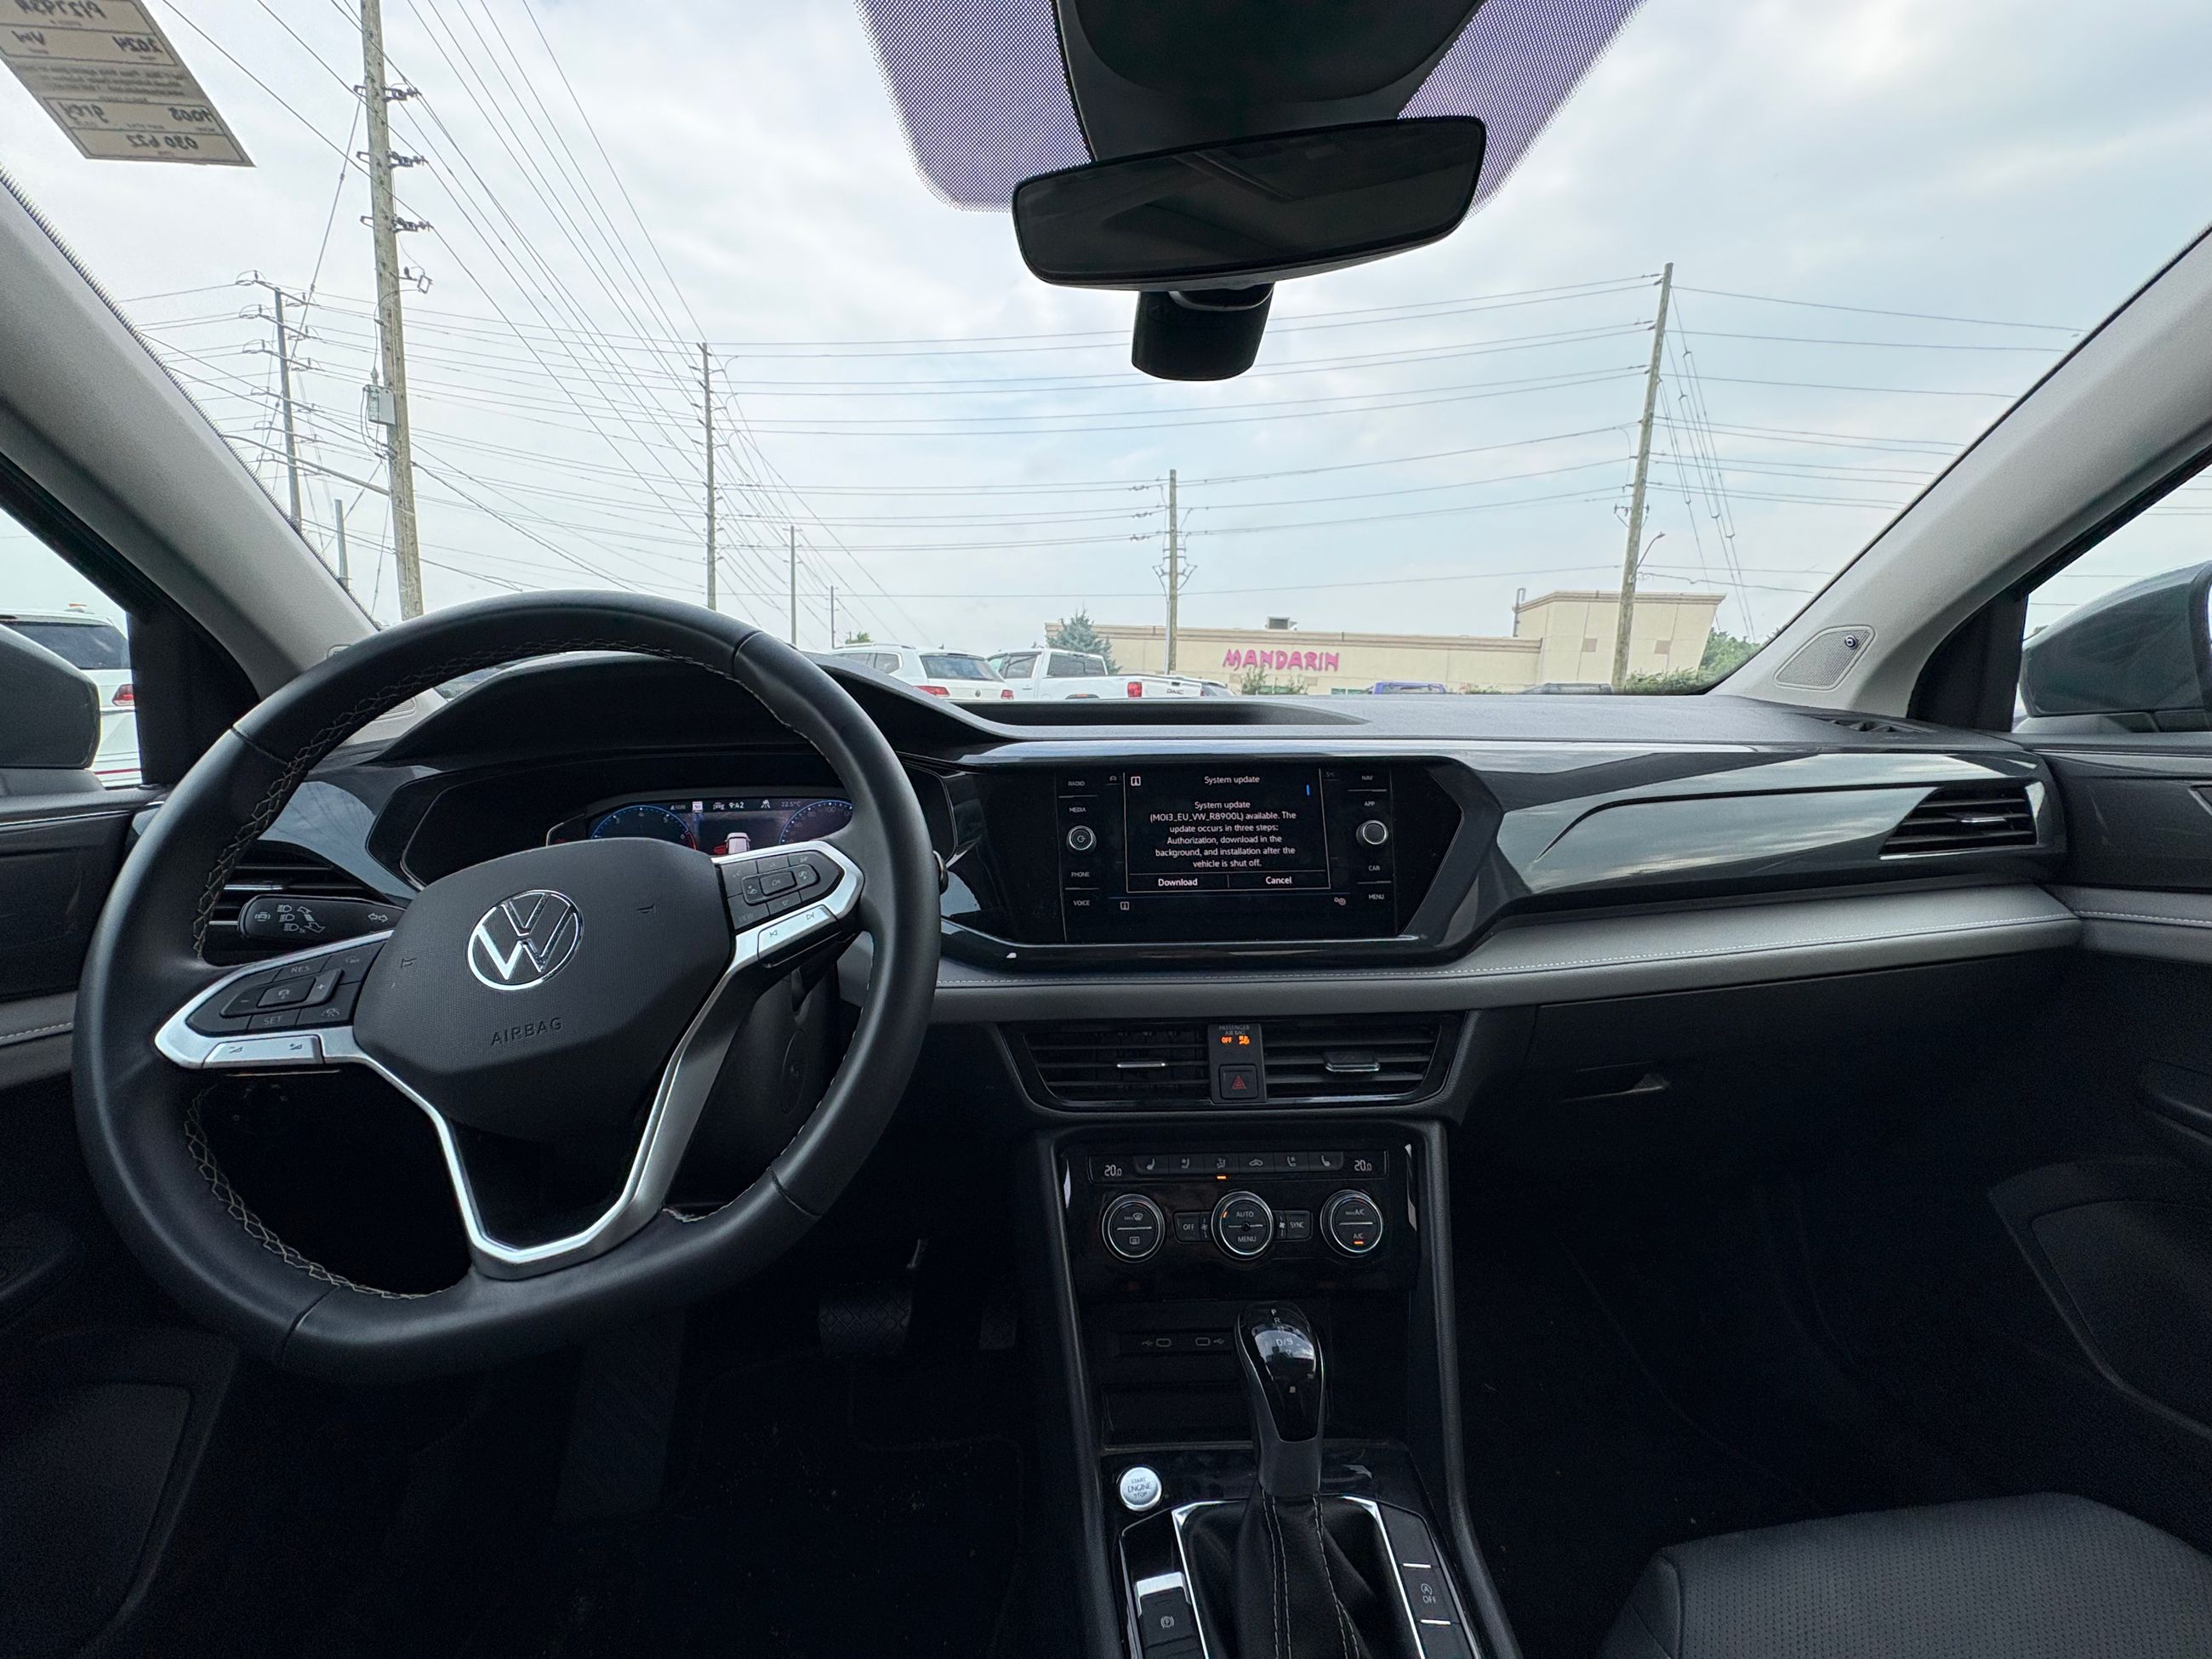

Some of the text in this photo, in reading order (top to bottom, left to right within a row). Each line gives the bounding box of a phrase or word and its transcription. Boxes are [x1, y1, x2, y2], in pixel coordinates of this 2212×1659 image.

[1223, 648, 1340, 671] MANDARIN
[1204, 775, 1261, 786] System update
[1194, 801, 1251, 812] System update
[1245, 811, 1281, 820] available.
[1281, 811, 1297, 819] The
[1169, 825, 1196, 835] update
[1234, 824, 1255, 832] three
[1256, 824, 1279, 833] steps:
[1166, 836, 1219, 846] Authorization,
[1220, 835, 1258, 844] download
[1154, 847, 1296, 858] background, and installation after the
[1192, 858, 1262, 868] vehicle is shut off.
[1157, 877, 1199, 887] Download
[1265, 875, 1292, 885] Cancel
[290, 964, 311, 974] RES
[264, 1015, 283, 1025] SET
[490, 1017, 563, 1046] AIRBAG
[1182, 1223, 1195, 1232] OFF
[1422, 1595, 1437, 1605] OFF
